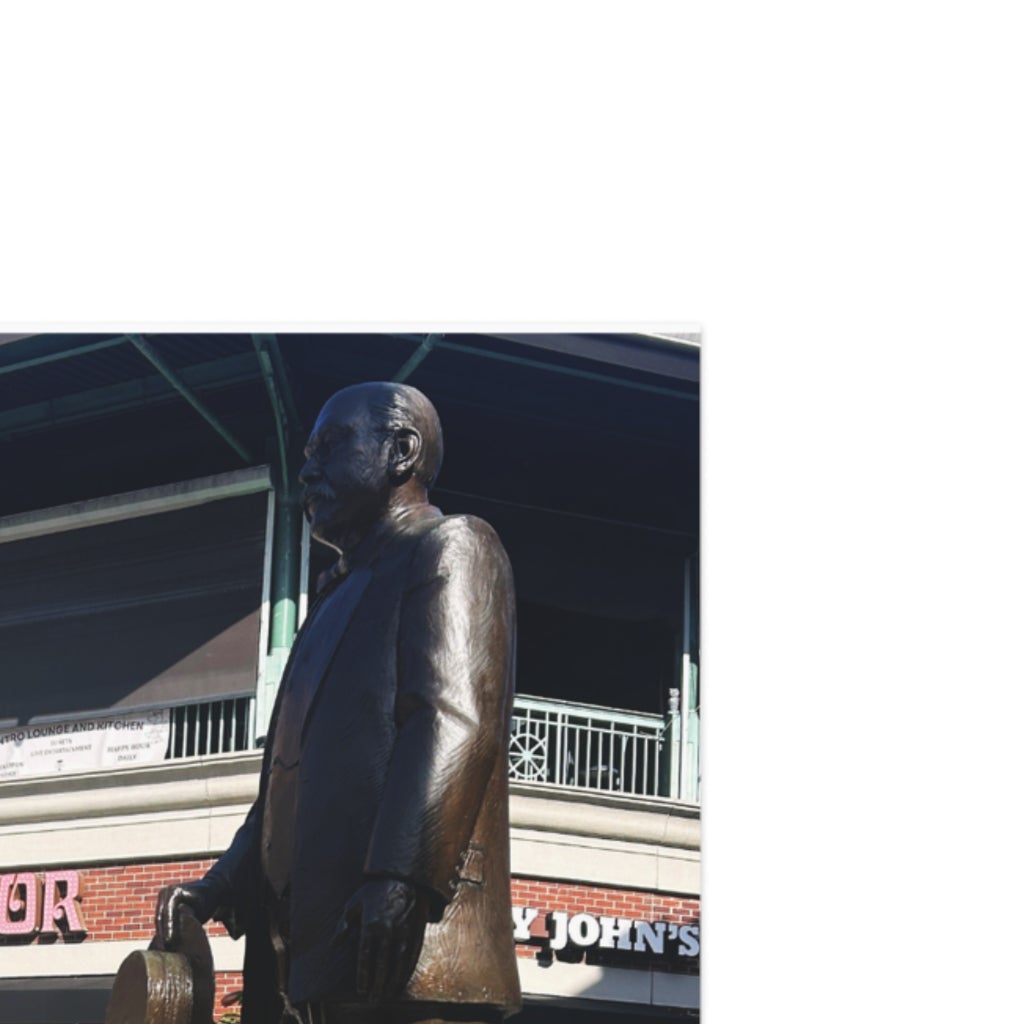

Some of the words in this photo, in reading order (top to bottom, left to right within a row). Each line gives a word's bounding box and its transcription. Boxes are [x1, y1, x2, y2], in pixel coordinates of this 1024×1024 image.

[27, 724, 70, 739] LOUNGE
[72, 722, 95, 733] AND
[97, 720, 144, 732] KITCHEN
[550, 910, 700, 957] JOHN'S
